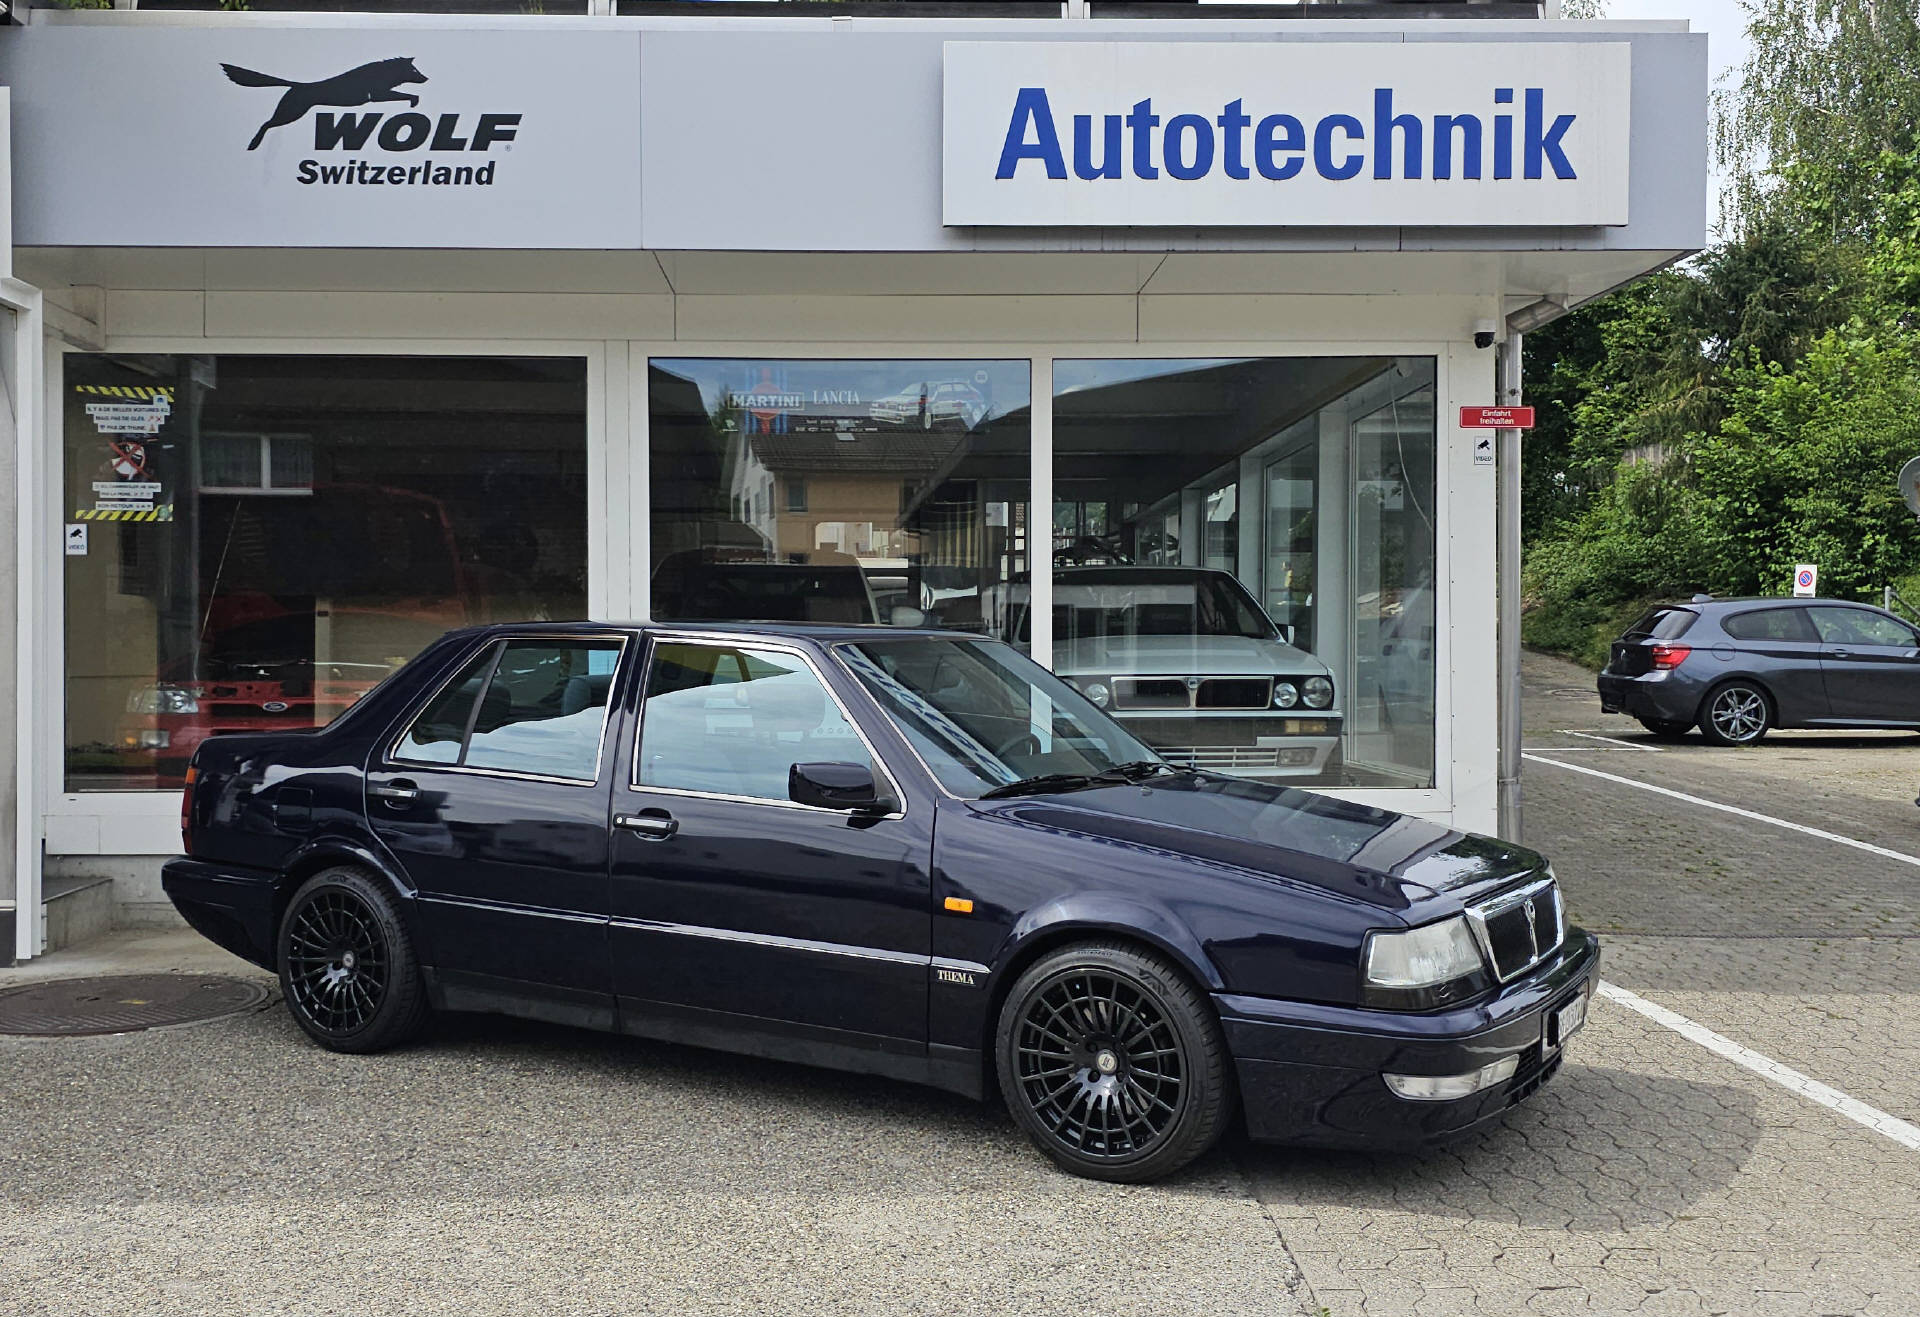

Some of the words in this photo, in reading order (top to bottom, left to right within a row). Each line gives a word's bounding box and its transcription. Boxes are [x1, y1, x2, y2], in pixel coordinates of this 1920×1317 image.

[314, 112, 523, 151] WOLF
[995, 88, 1577, 180] Autotechnik
[296, 159, 496, 185] Switzerland
[732, 394, 800, 407] MARTINI
[812, 390, 860, 405] LANCIA
[1480, 417, 1514, 425] freihalten
[1482, 409, 1511, 417] Einfahrt
[937, 969, 975, 985] THEMA
